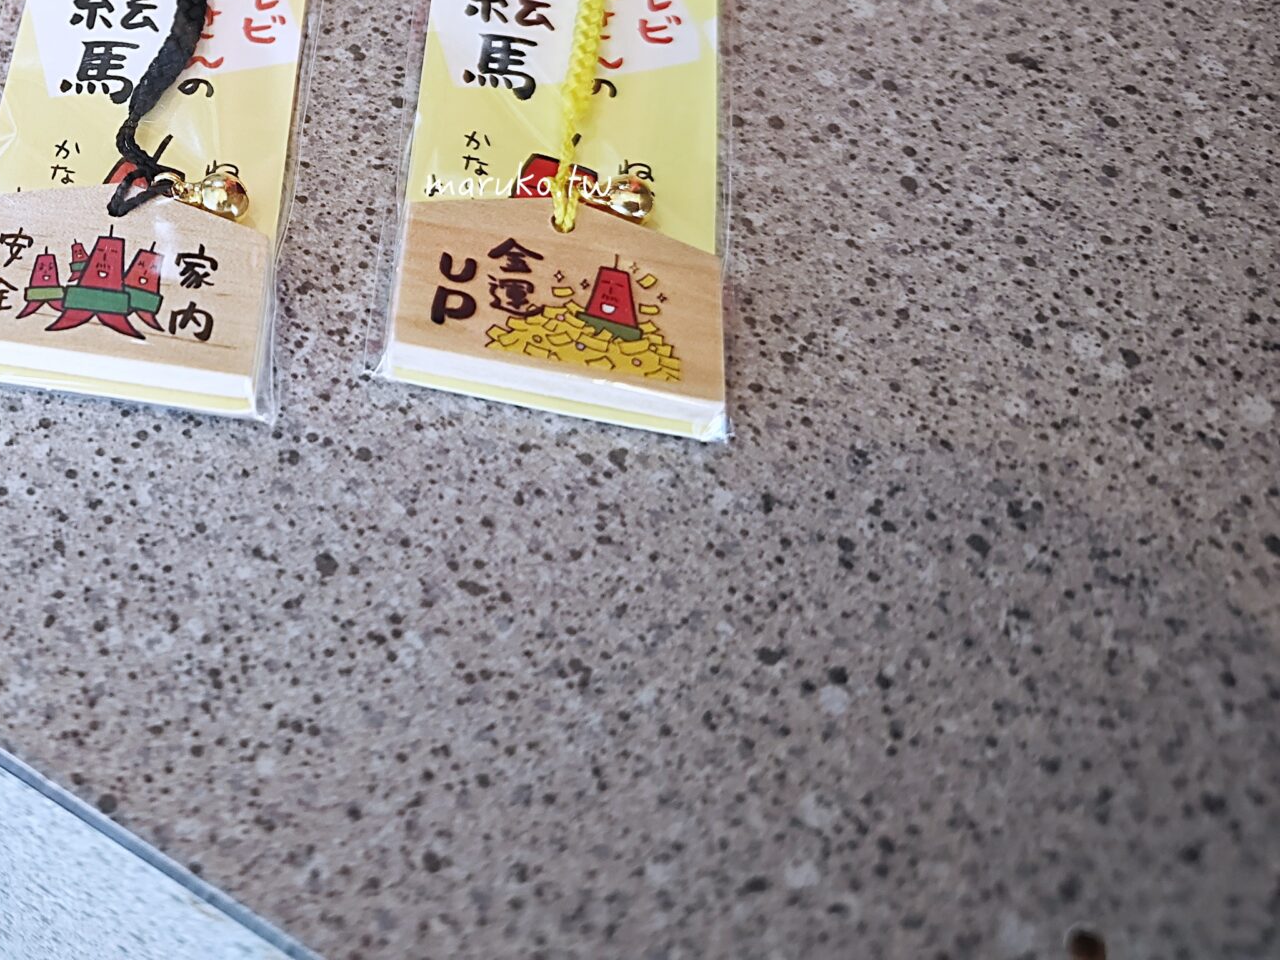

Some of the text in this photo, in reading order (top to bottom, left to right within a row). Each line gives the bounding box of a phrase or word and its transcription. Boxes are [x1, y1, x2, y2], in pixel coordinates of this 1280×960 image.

[50, 139, 80, 184] かな
[169, 244, 218, 341] 家内
[430, 251, 477, 325] UP
[487, 237, 544, 316] 金運
